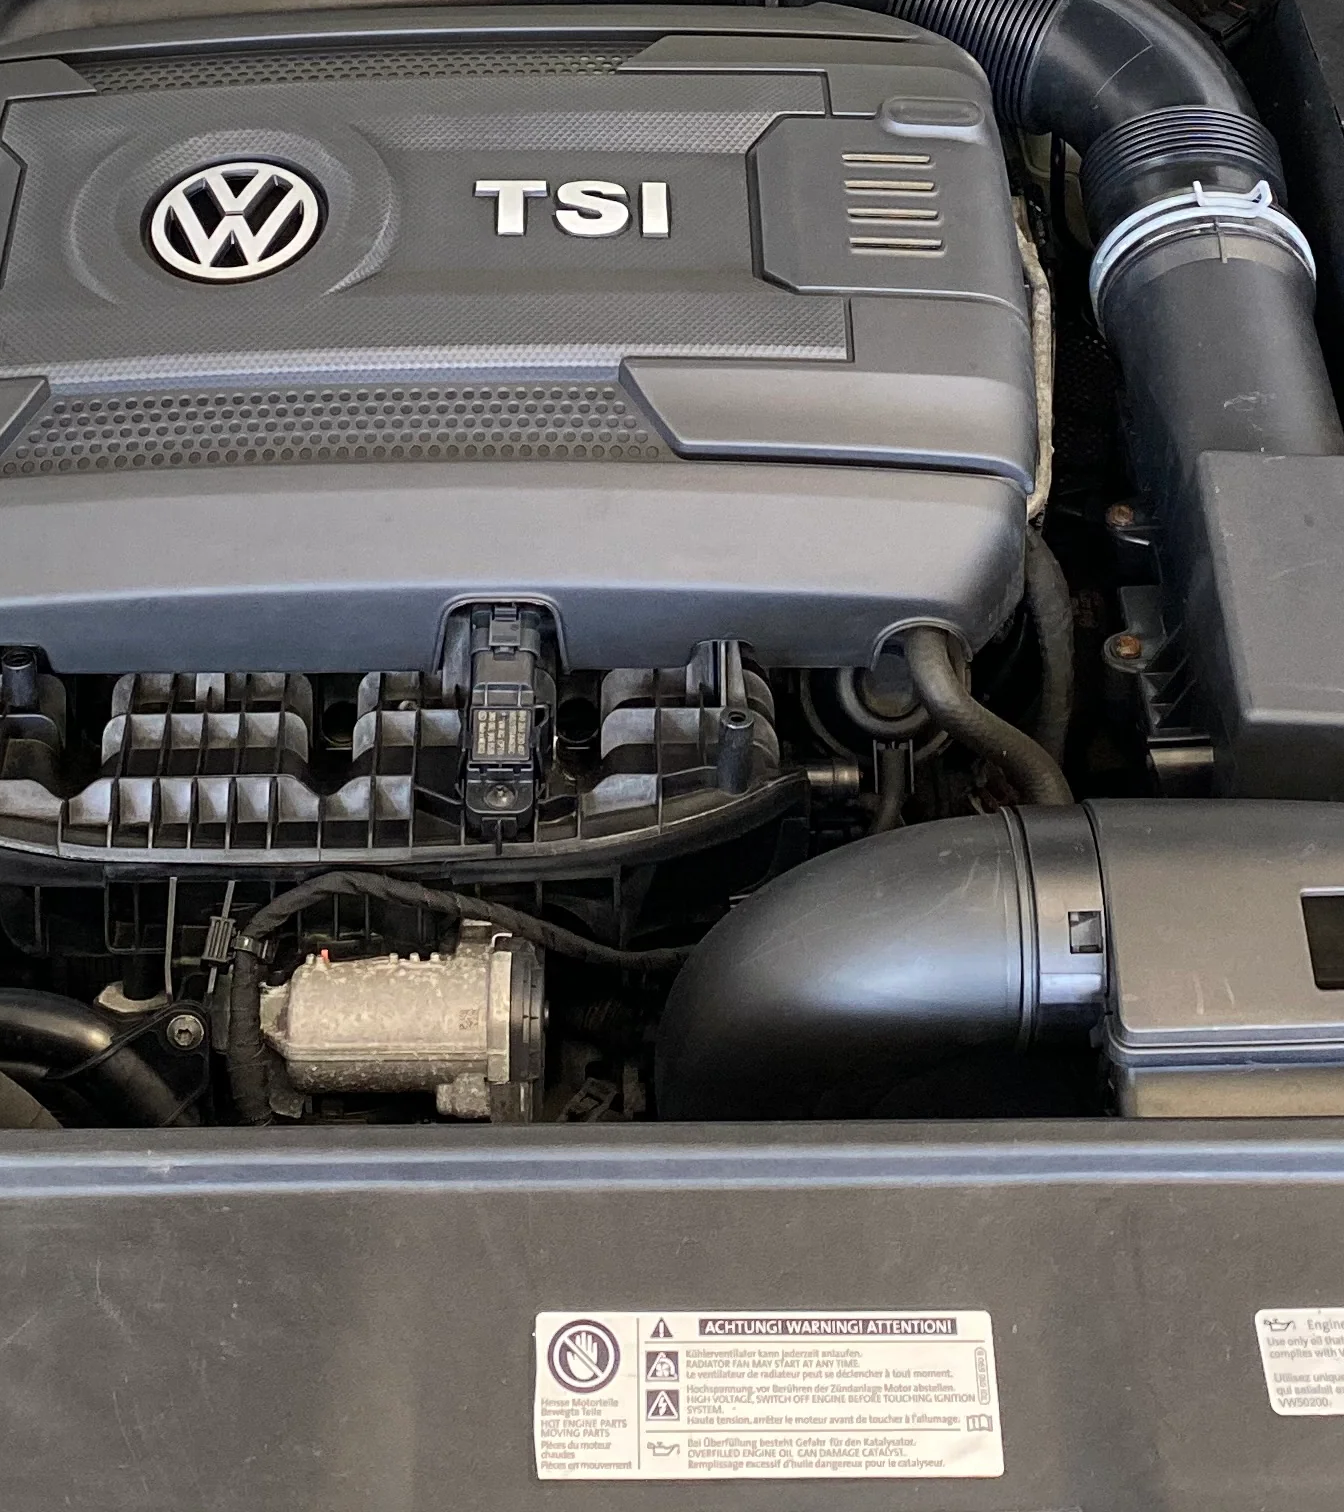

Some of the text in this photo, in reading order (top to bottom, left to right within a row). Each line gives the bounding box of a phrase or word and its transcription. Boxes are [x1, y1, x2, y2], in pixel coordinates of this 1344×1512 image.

[474, 179, 672, 238] TSI
[705, 1320, 951, 1334] ACHTUNG! WARNING! ATTENTION!
[1267, 1337, 1285, 1346] Use
[1287, 1337, 1308, 1348] only
[1311, 1336, 1323, 1345] oil
[1270, 1349, 1312, 1361] complies
[1314, 1348, 1337, 1357] with
[686, 1359, 730, 1368] RADIATOR
[732, 1359, 750, 1368] FAN
[752, 1359, 772, 1368] MAY
[775, 1359, 799, 1368] START
[803, 1359, 813, 1368] AT
[815, 1359, 834, 1368] ANY
[698, 1369, 745, 1378] ventilateur
[747, 1369, 758, 1378] de
[760, 1369, 800, 1378] radiateur
[802, 1370, 822, 1381] peut
[824, 1369, 834, 1378] se
[892, 1369, 911, 1378] tout
[1274, 1372, 1311, 1382] Utilisez
[816, 1384, 828, 1393] der
[884, 1384, 911, 1393] Motor
[1276, 1385, 1292, 1396] qui
[572, 1398, 618, 1407] Motorteile
[687, 1394, 710, 1404] HIGH
[756, 1394, 791, 1404] SWITCH
[793, 1394, 810, 1404] OFF
[812, 1394, 846, 1404] ENGINE
[848, 1394, 881, 1404] BEFORE
[884, 1394, 932, 1404] TOUCHING
[934, 1394, 976, 1404] IGNITION
[687, 1405, 724, 1414] SYSTEM.
[541, 1419, 628, 1428] HOT ENGINE PARTS
[687, 1415, 714, 1425] Haute
[795, 1415, 828, 1425] moteur
[829, 1415, 854, 1425] avant
[856, 1415, 868, 1425] de
[869, 1415, 903, 1425] toucher
[541, 1429, 611, 1438] MOVING PARTS
[568, 1441, 580, 1449] du
[581, 1441, 611, 1449] moteur
[795, 1438, 826, 1448] Gefahr
[844, 1438, 861, 1448] den
[688, 1448, 907, 1458] OVERFILLED ENGINE OIL CAN DAMAGE CATALYST.
[581, 1461, 632, 1470] mouvement
[688, 1459, 744, 1470] Remplissage
[746, 1459, 781, 1469] excessif
[815, 1459, 862, 1470] dangereux
[865, 1460, 885, 1469] pour
